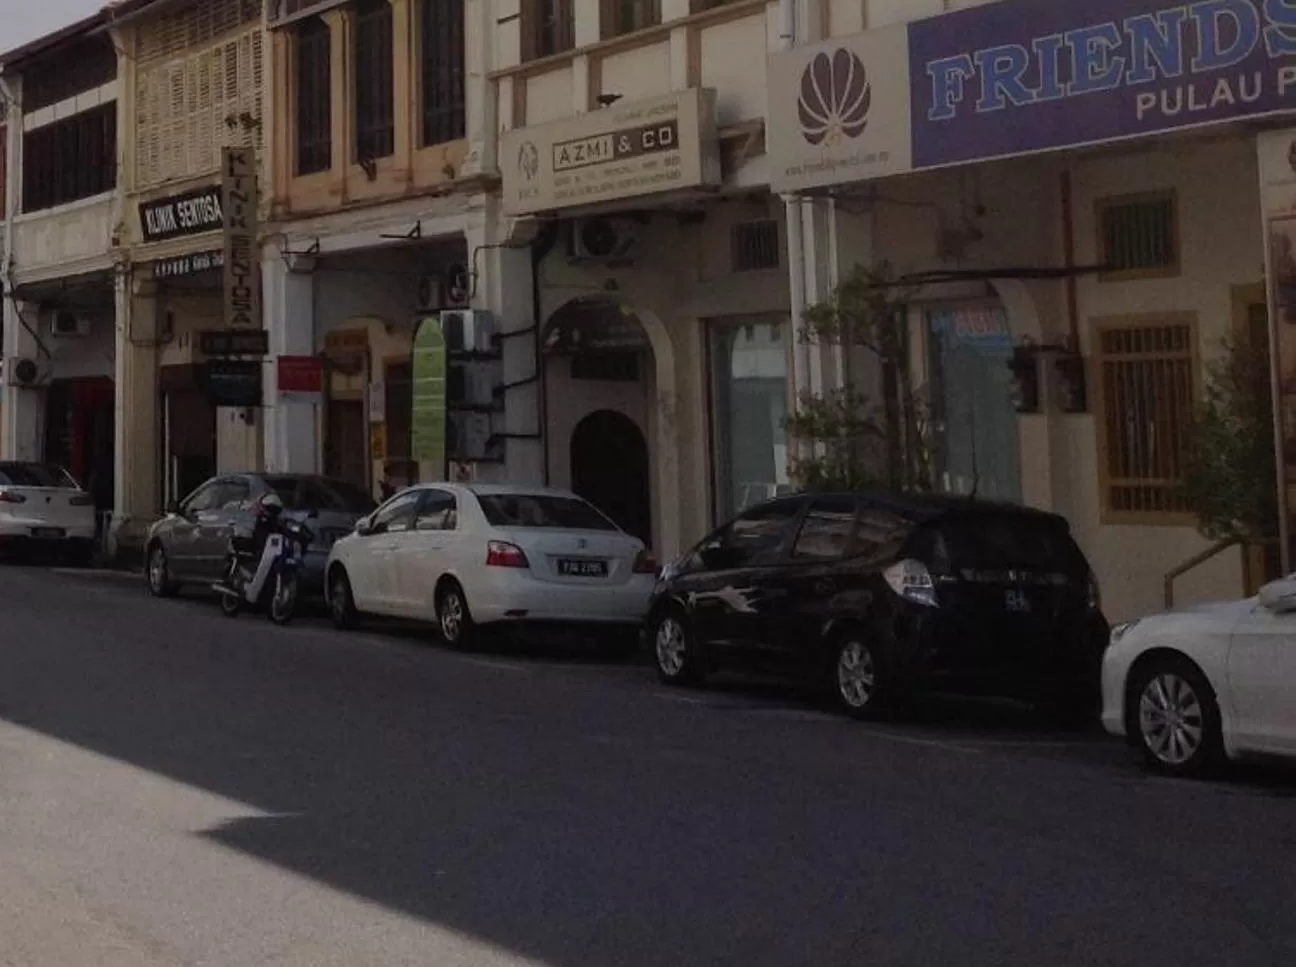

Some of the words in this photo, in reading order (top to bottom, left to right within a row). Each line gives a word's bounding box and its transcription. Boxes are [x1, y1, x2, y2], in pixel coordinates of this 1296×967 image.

[1136, 71, 1263, 121] PULAU
[559, 139, 609, 165] AZMI
[618, 135, 633, 153] &
[642, 126, 673, 149] CO
[228, 152, 250, 230] KLINIK
[145, 202, 177, 235] KLINIK
